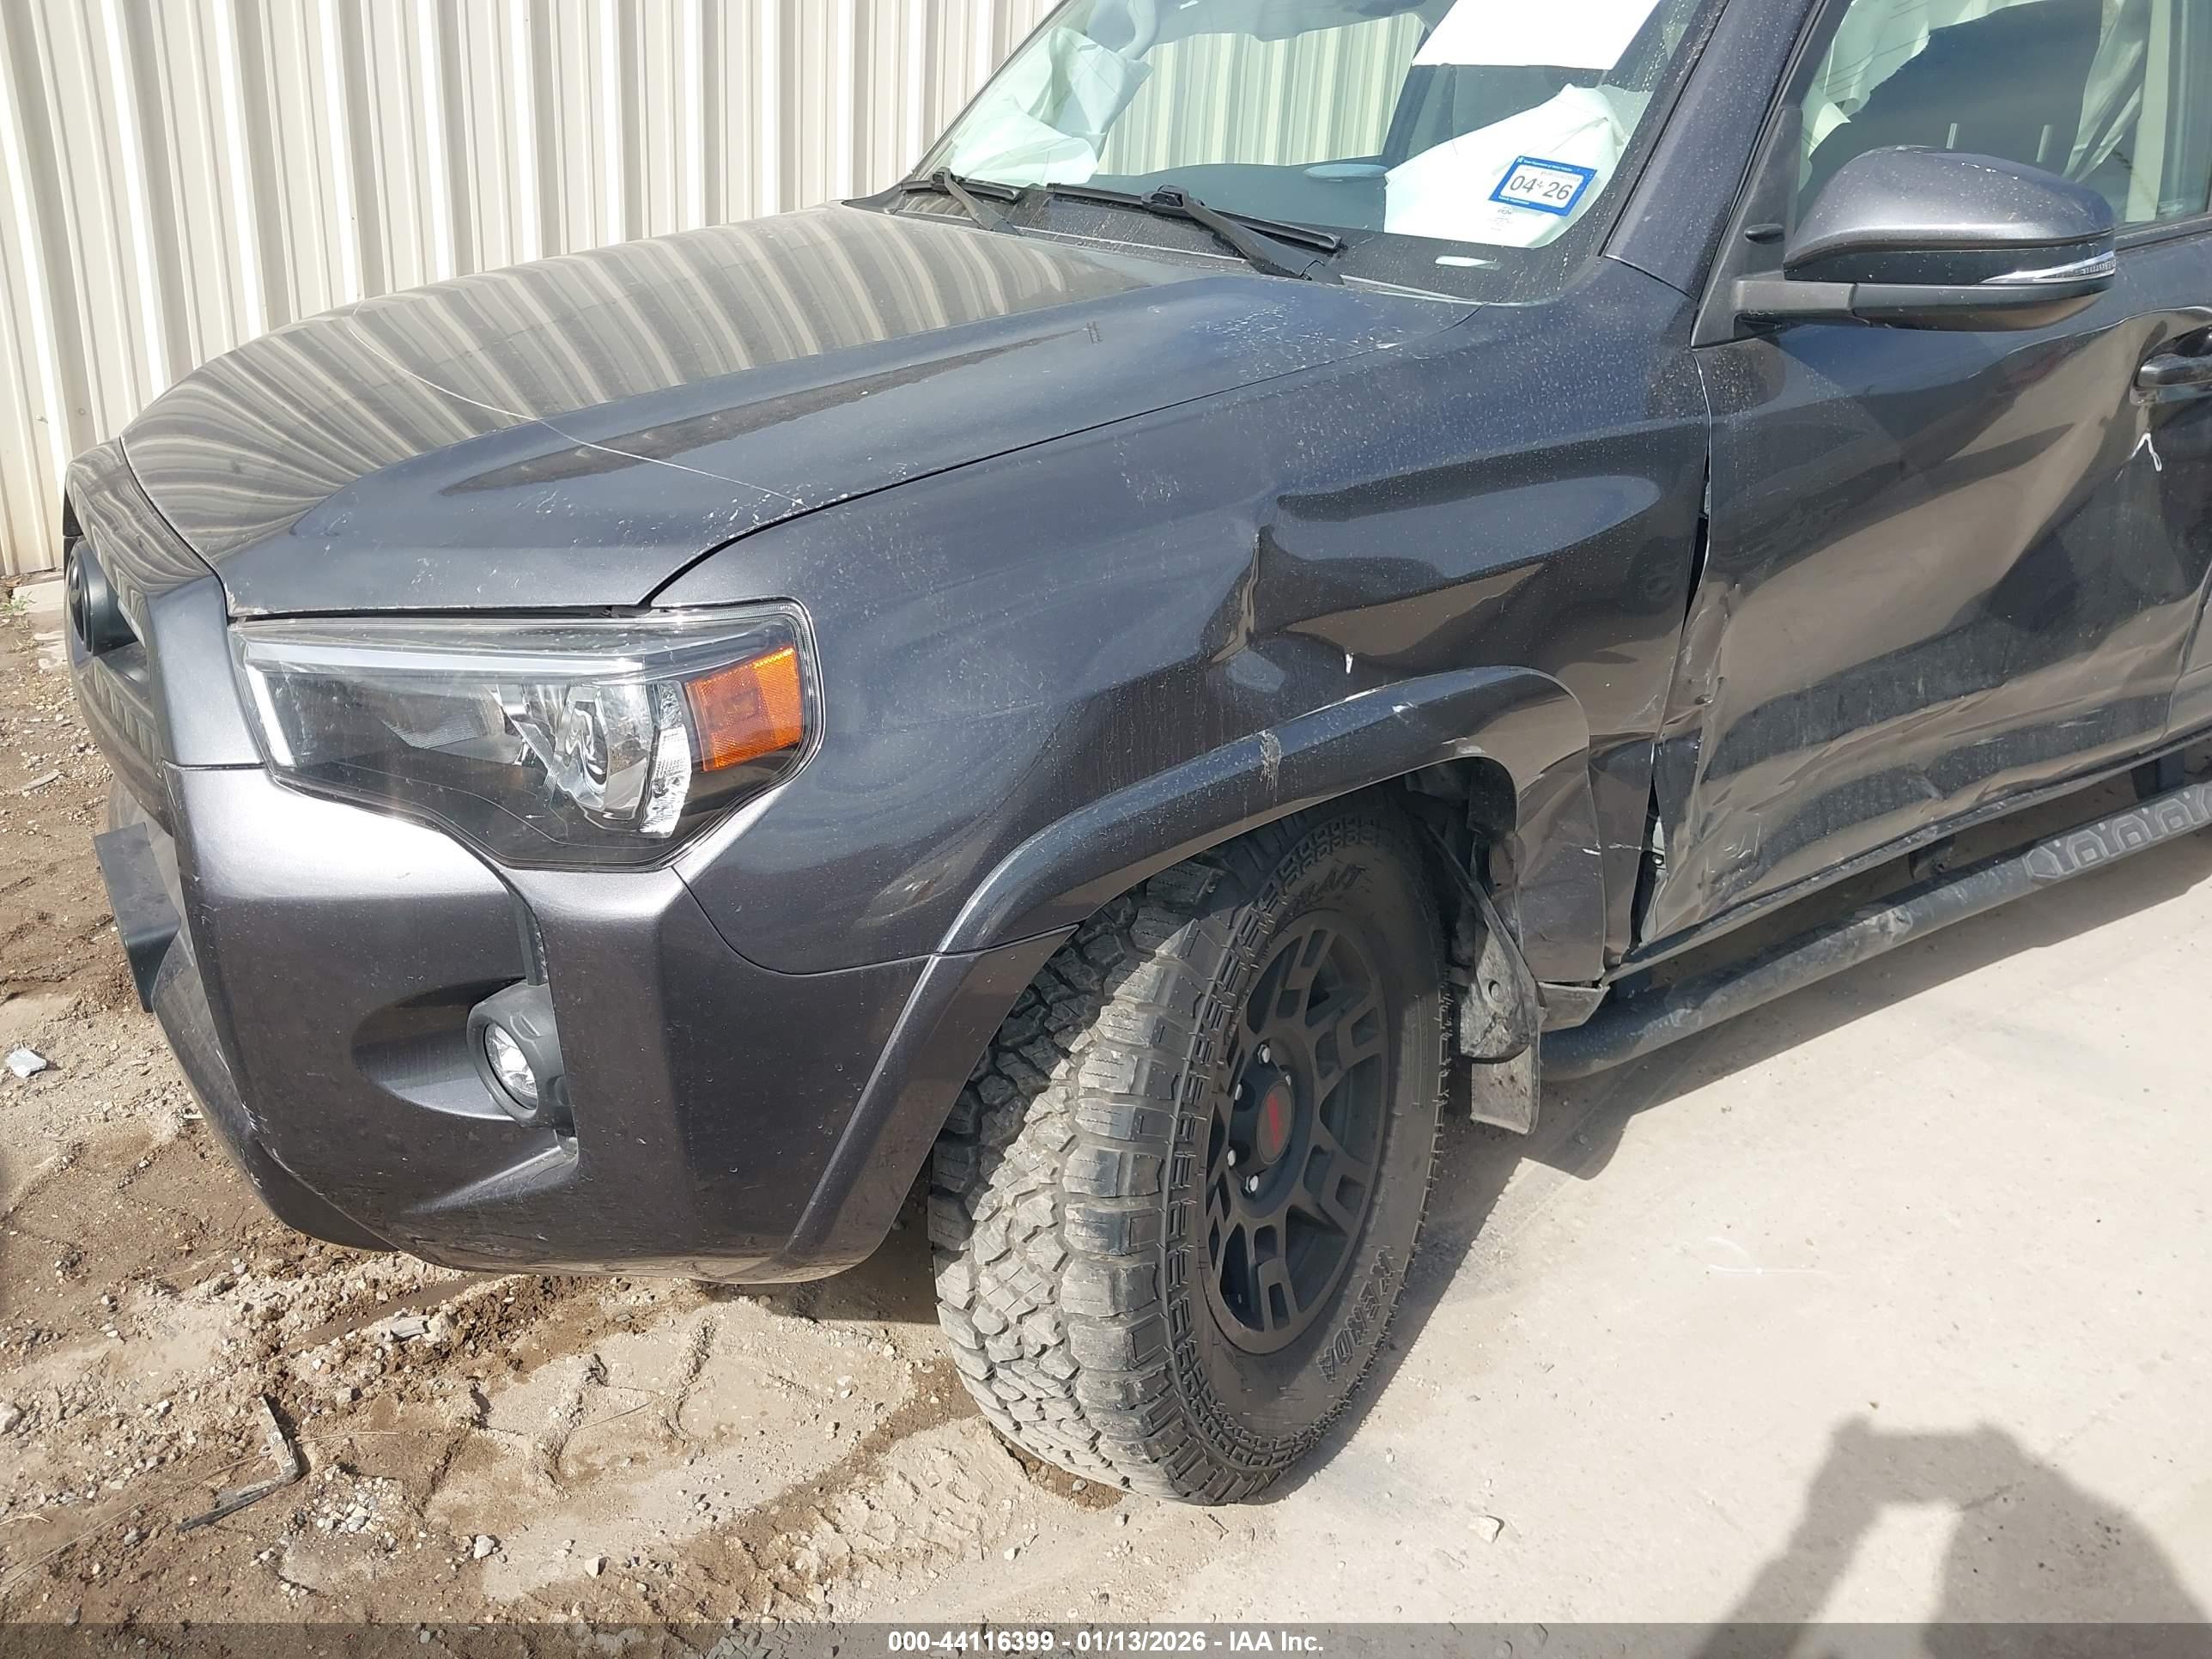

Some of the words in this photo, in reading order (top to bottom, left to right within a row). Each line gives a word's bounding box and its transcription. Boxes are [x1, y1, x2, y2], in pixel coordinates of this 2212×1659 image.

[1510, 174, 1538, 193] 04
[1542, 181, 1573, 201] 26
[1316, 1249, 1392, 1384] KENDA
